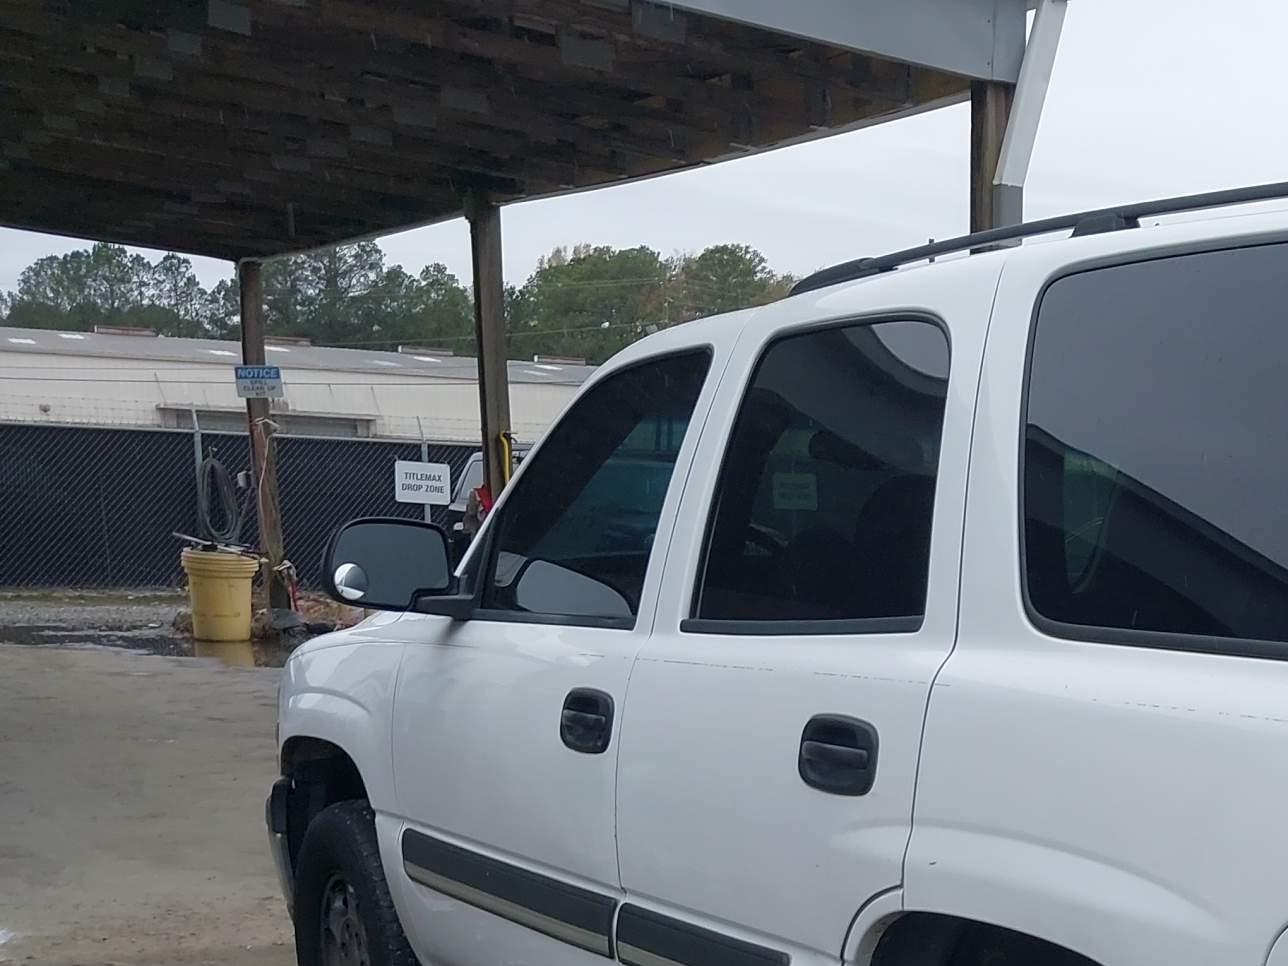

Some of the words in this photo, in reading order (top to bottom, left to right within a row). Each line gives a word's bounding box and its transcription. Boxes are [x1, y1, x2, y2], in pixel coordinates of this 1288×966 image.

[238, 368, 279, 378] NOTICE
[404, 471, 443, 482] TITLEMAX
[401, 483, 423, 492] DROP
[425, 485, 445, 494] ZONE
